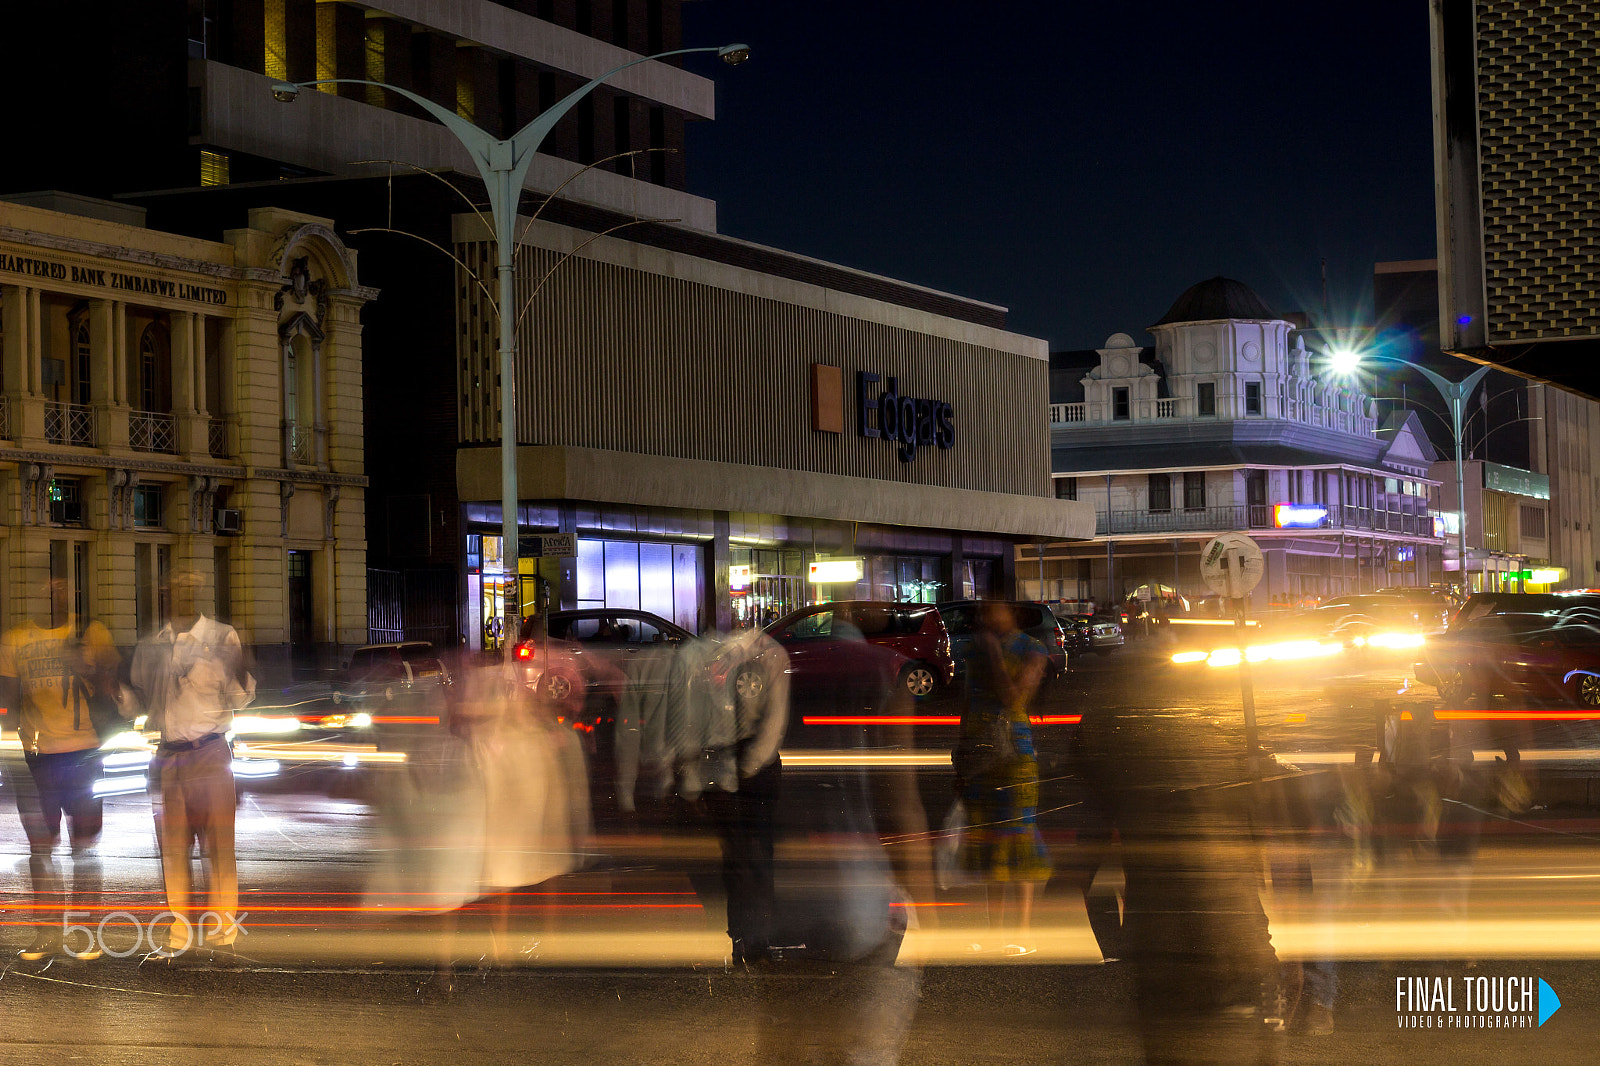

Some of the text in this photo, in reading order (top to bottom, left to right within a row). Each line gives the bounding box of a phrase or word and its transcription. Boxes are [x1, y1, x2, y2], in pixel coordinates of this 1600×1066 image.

[71, 265, 106, 287] BANK
[110, 272, 176, 298] ZIMBABWE
[178, 283, 227, 305] LIMITED
[856, 370, 956, 463] Edgars
